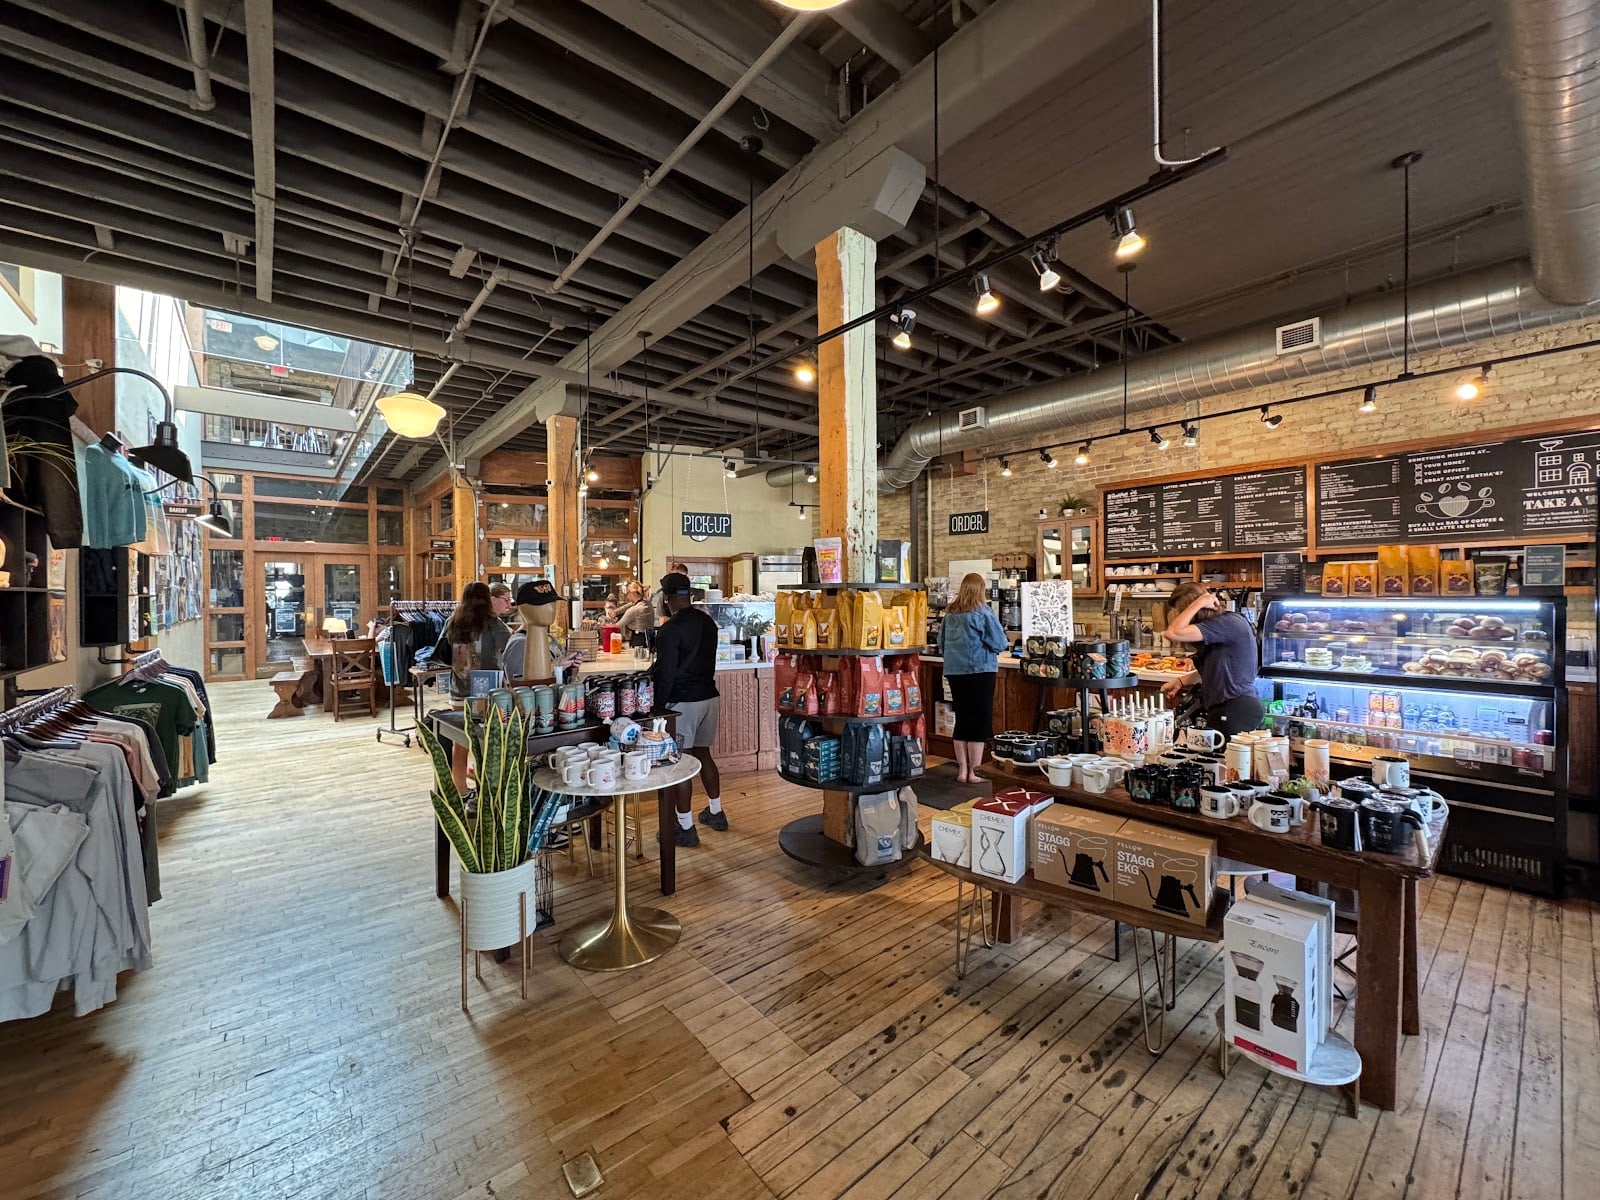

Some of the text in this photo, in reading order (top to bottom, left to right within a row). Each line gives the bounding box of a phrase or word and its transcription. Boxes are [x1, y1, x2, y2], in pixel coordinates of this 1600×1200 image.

[1408, 454, 1446, 463] SOMETHING
[1526, 489, 1564, 497] WELCOME
[1523, 497, 1567, 510] TAKE
[1569, 496, 1582, 507] A
[683, 514, 730, 534] PICK-UP
[980, 814, 1006, 825] CHEMEX
[938, 825, 961, 835] CHEMEX
[1038, 823, 1060, 832] FELLOW
[1038, 831, 1070, 847] STAGG
[1038, 840, 1057, 854] EKG
[1117, 841, 1143, 851] FELLOW
[1117, 850, 1155, 869] STAGG
[1117, 861, 1139, 876] EKG
